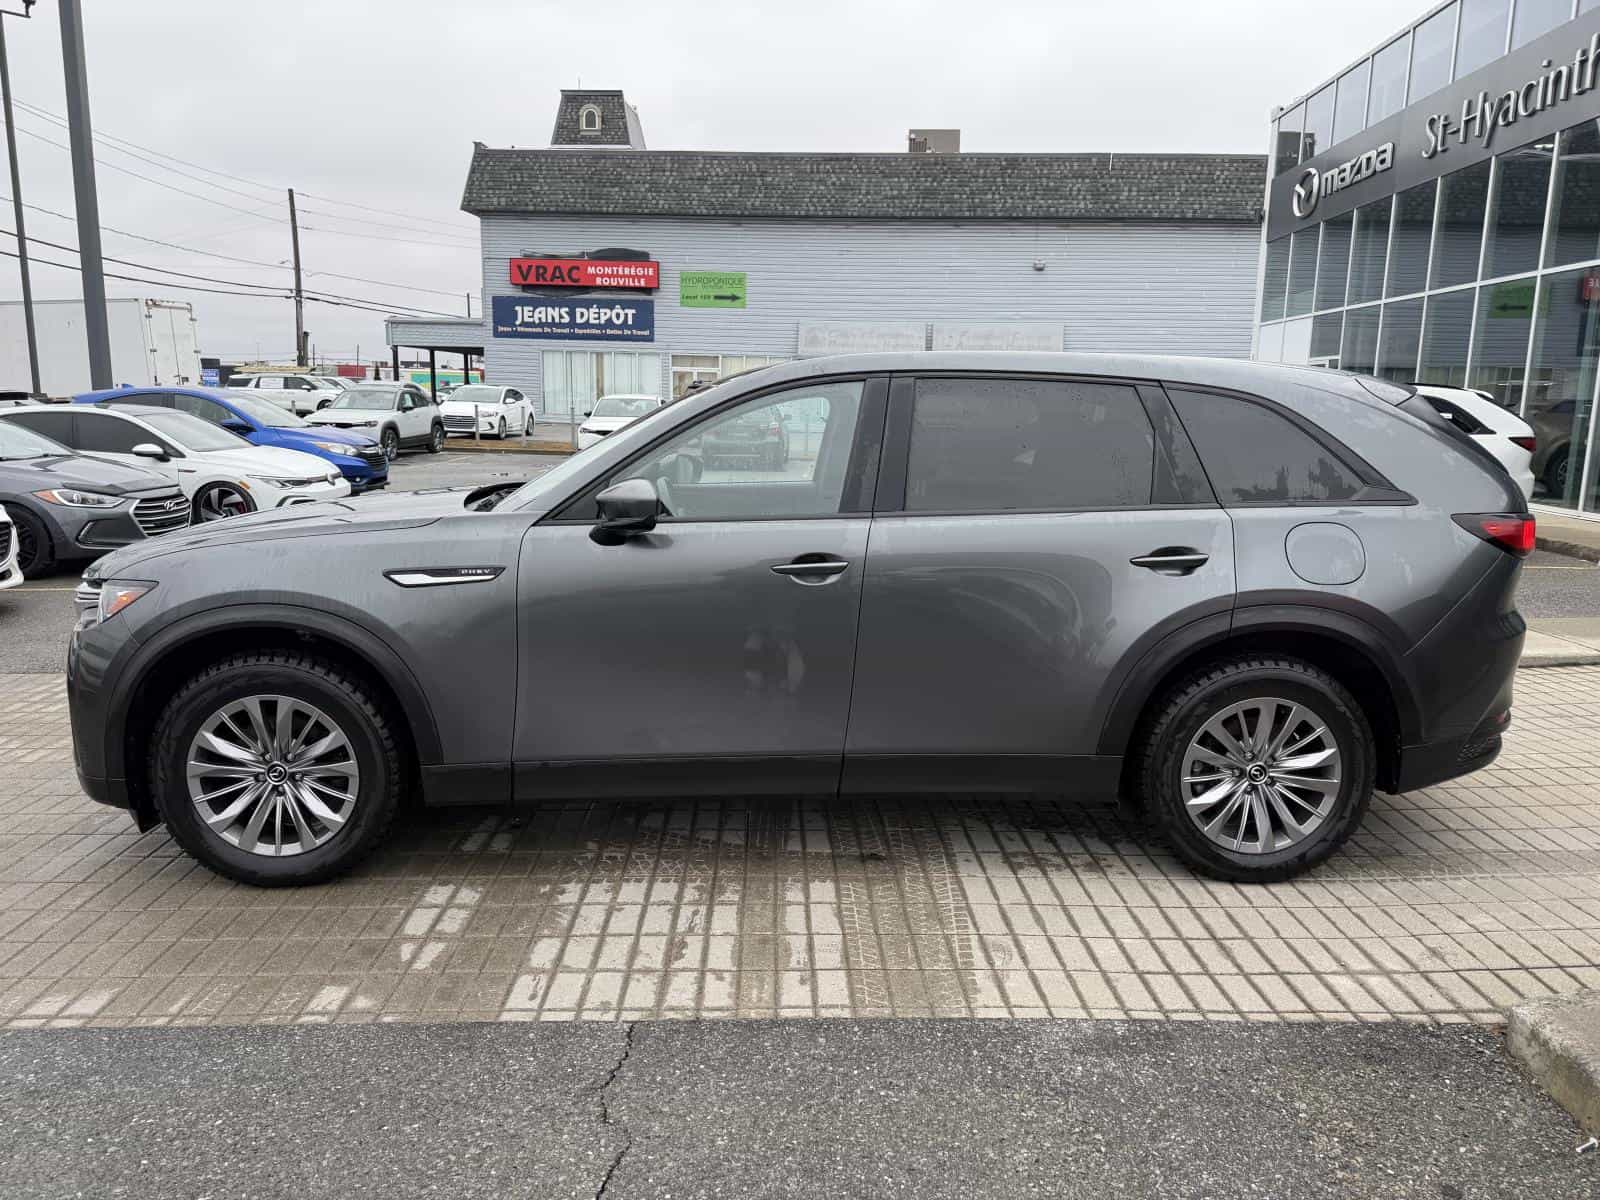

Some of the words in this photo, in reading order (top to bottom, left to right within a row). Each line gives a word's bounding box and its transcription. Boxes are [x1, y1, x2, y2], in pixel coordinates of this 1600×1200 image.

[517, 265, 581, 283] VRAC
[587, 265, 655, 276] MONTÉRÉGIE
[595, 277, 646, 287] ROUVILLE
[514, 305, 570, 326] JEANS
[575, 304, 637, 326] DÉPÔT
